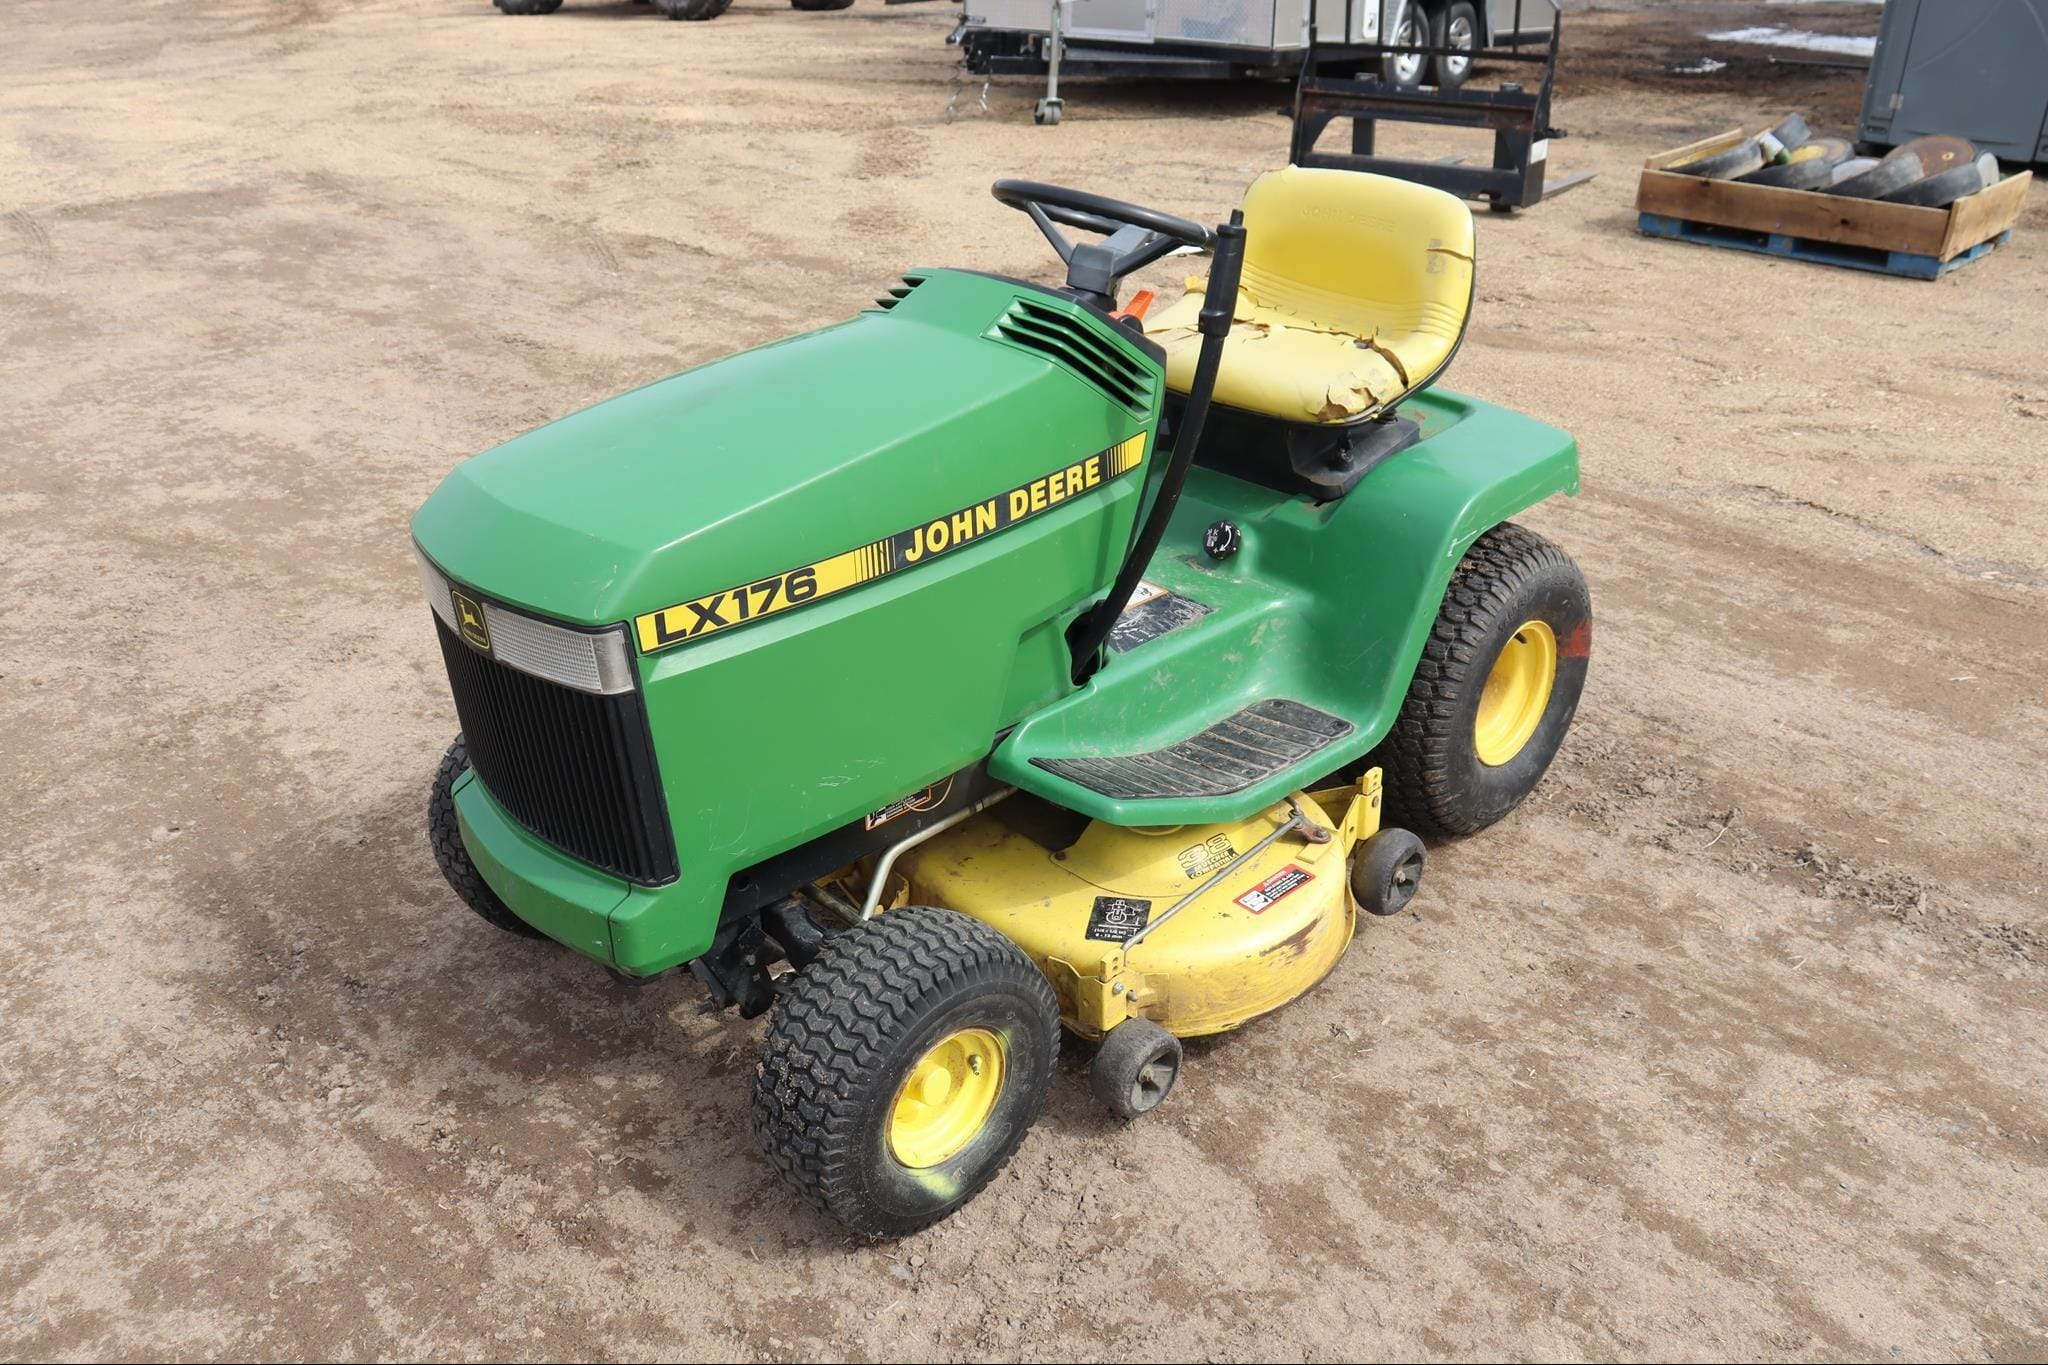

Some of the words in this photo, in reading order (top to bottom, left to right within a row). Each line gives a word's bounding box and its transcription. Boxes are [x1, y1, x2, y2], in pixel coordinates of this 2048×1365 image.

[905, 500, 997, 562] JOHN
[1010, 456, 1102, 521] DEERE
[655, 567, 816, 646] LX176
[1178, 833, 1231, 868] 38
[1194, 850, 1229, 871] MULCHER
